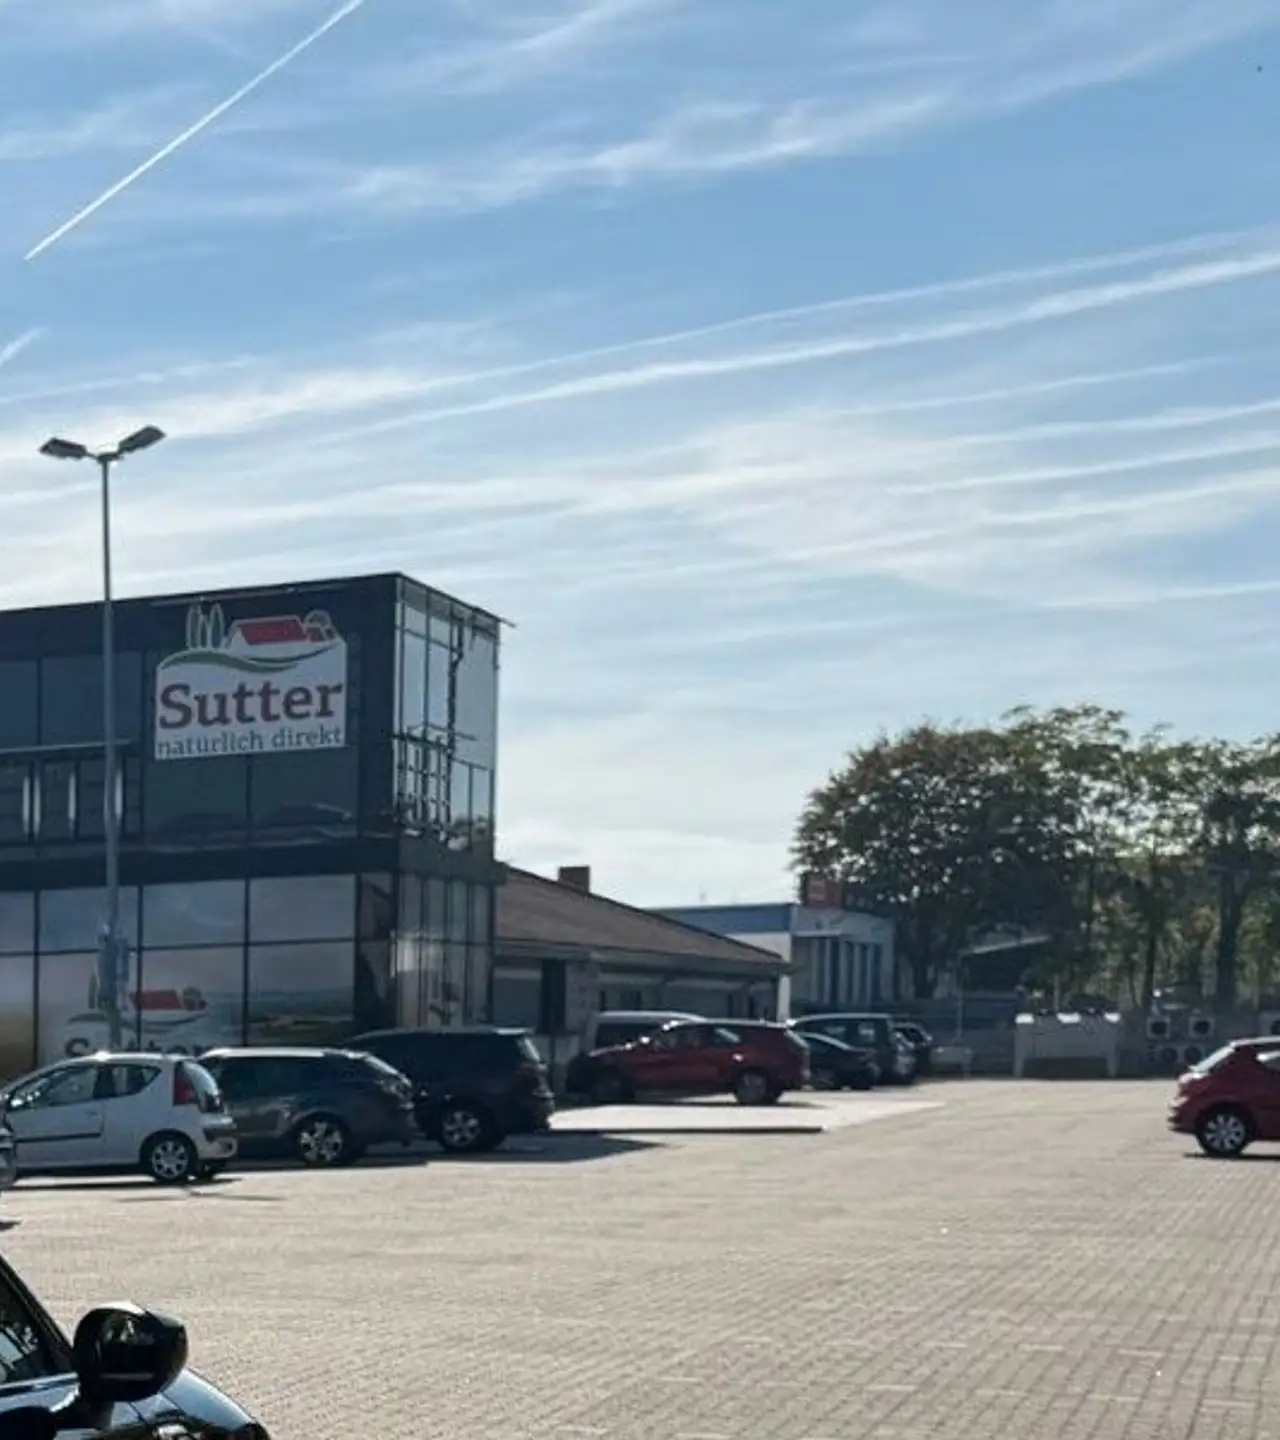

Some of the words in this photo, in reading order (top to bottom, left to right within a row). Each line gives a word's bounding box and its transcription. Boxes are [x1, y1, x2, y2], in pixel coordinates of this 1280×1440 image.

[158, 680, 343, 730] Sutter
[157, 730, 264, 757] natürlich
[271, 724, 342, 750] direkt
